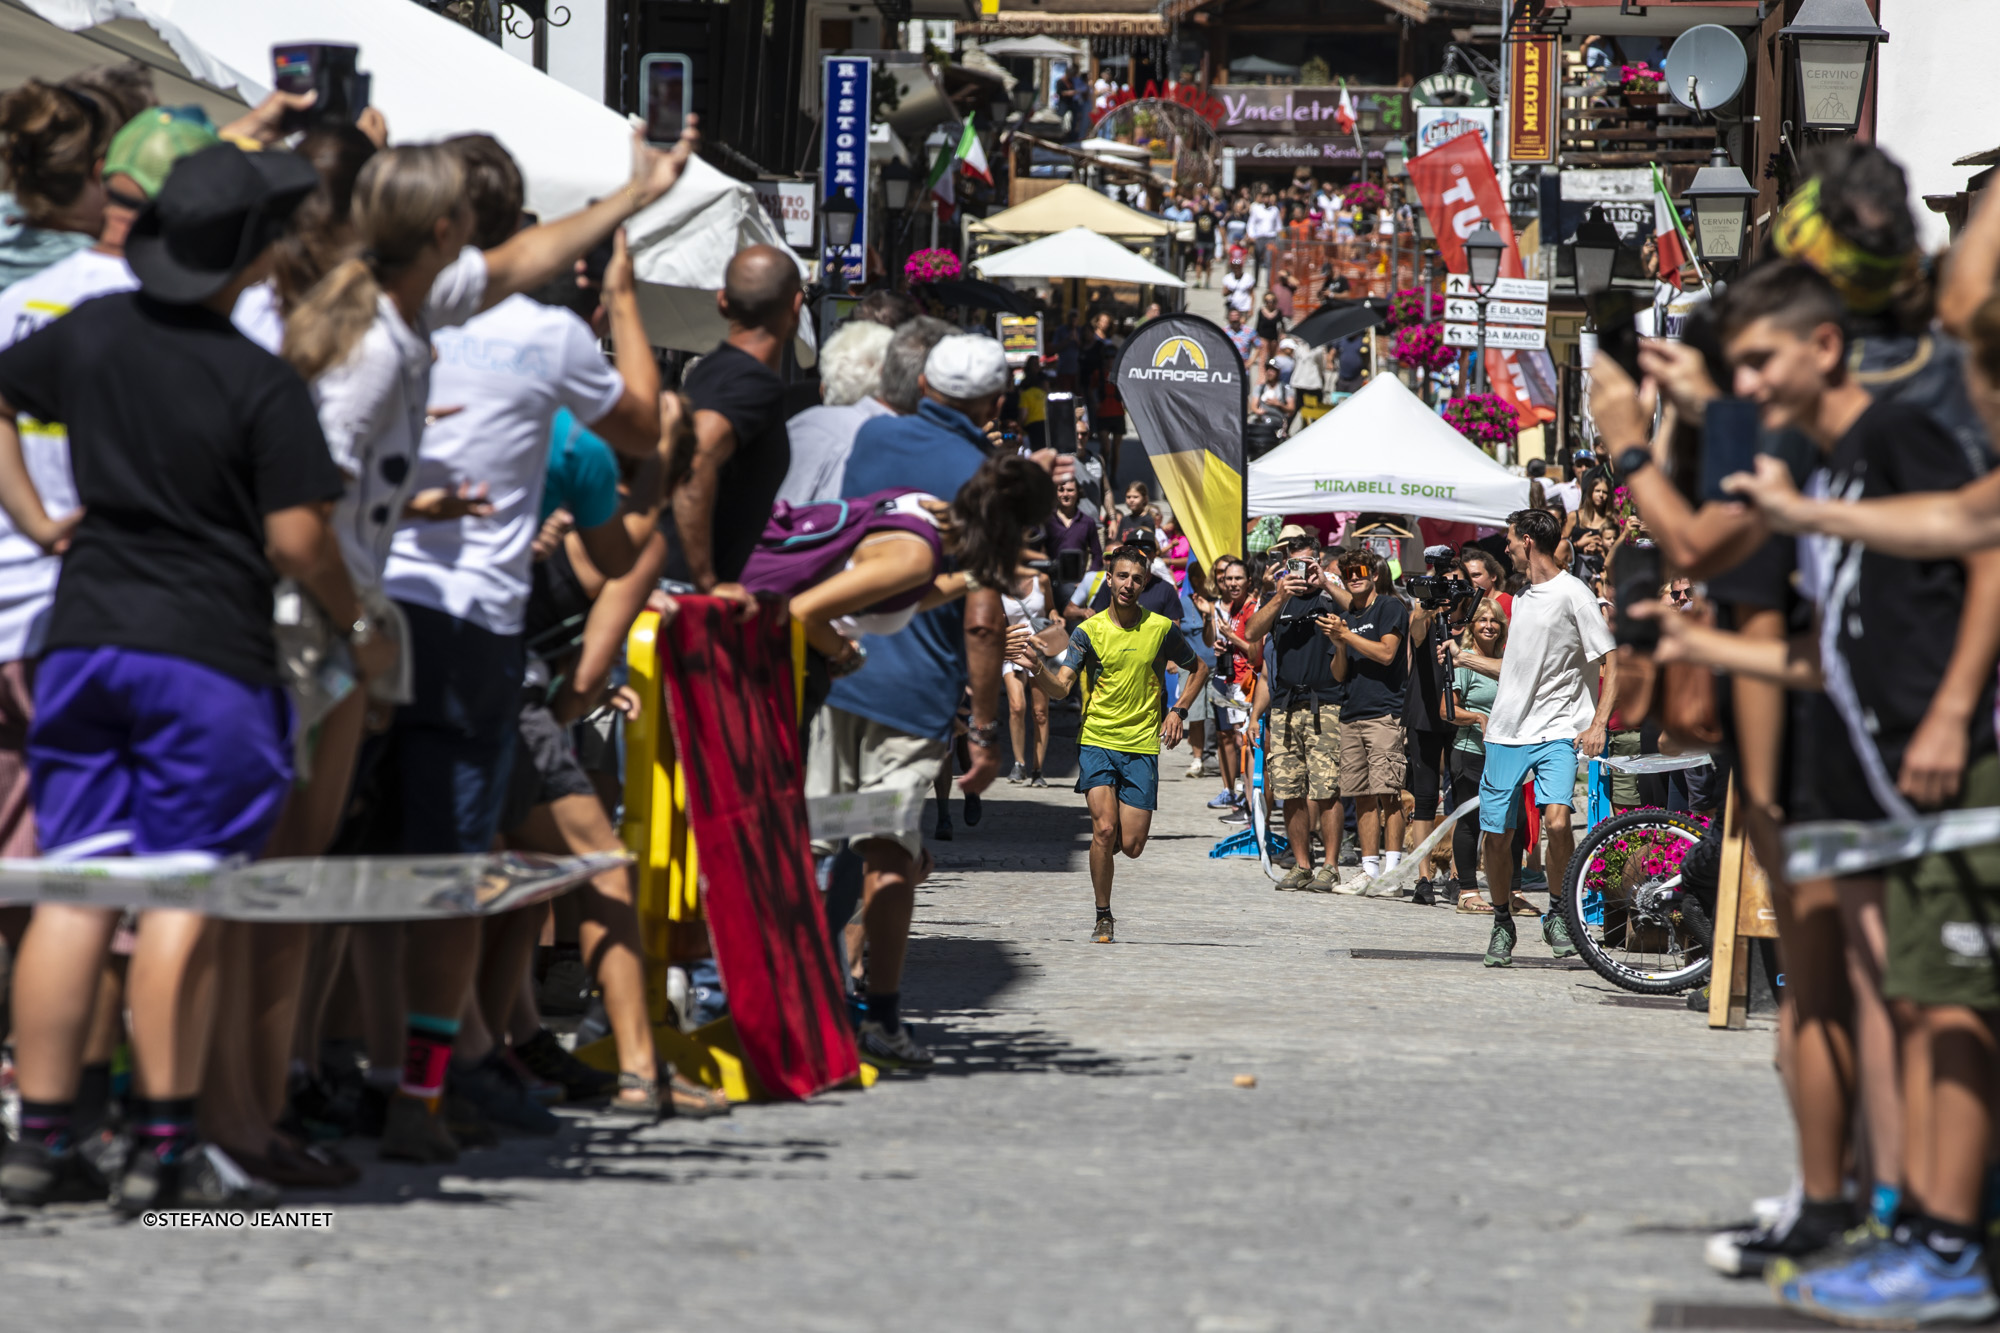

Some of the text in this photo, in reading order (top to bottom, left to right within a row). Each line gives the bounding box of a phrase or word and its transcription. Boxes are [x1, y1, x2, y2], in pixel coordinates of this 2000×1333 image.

[1806, 69, 1859, 80] CERVINO
[834, 63, 857, 198] RISTORA
[757, 191, 805, 208] ASTRO
[1701, 218, 1740, 226] CERVINO
[1499, 306, 1544, 317] BLASON
[1503, 330, 1540, 341] MARIO
[1314, 479, 1456, 499] MIRABELL SPORT
[1668, 819, 1703, 838] MAXX
